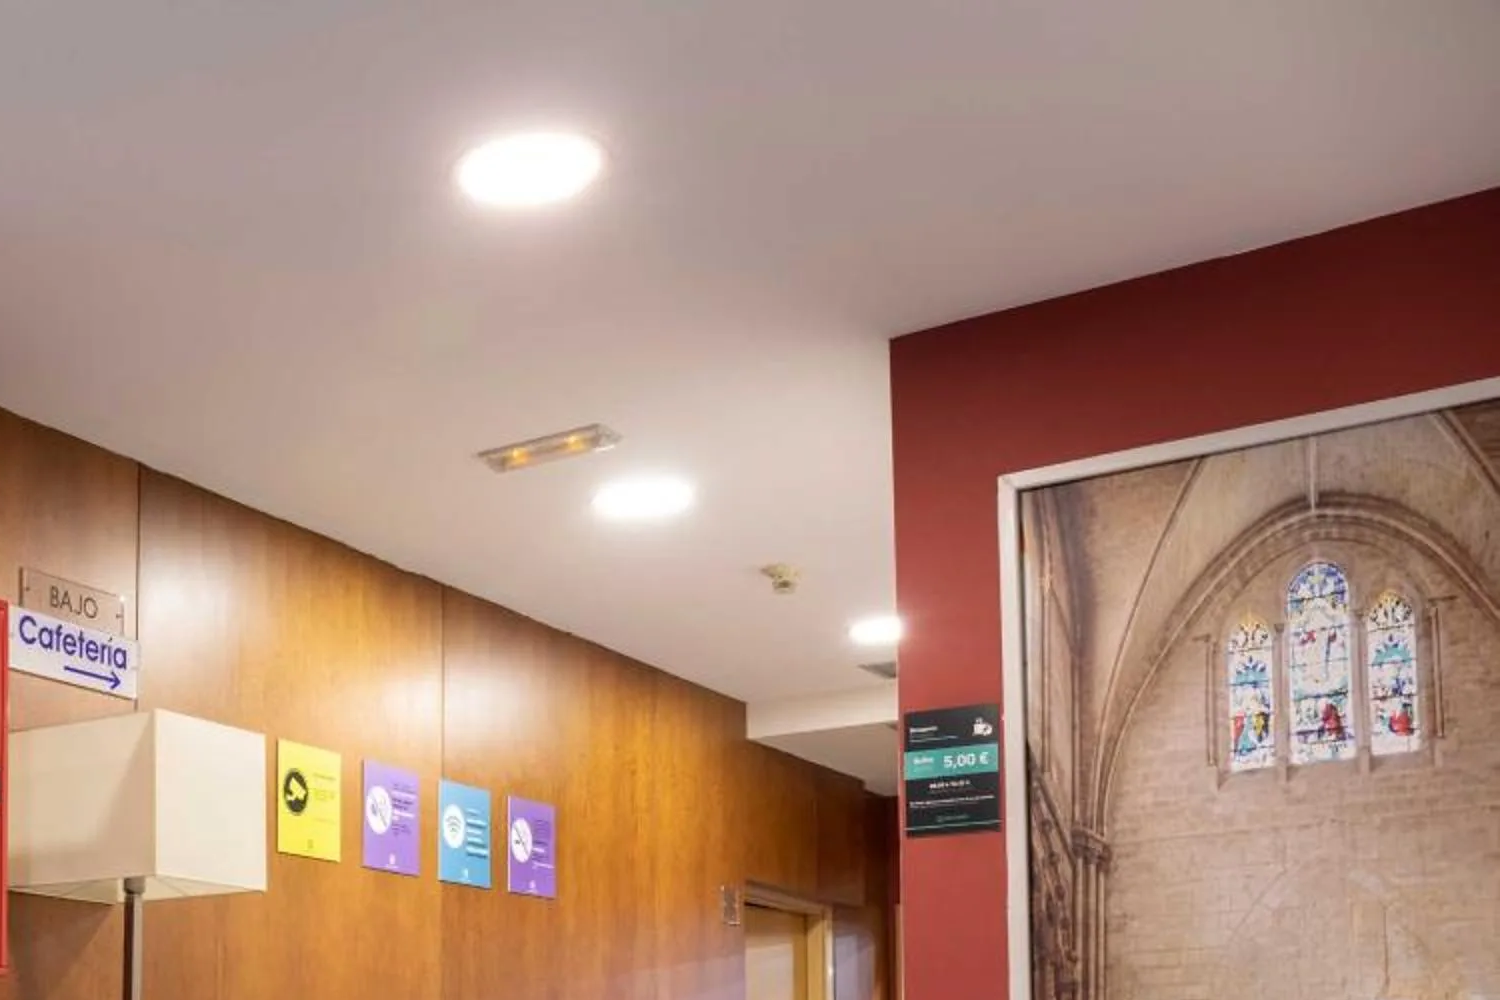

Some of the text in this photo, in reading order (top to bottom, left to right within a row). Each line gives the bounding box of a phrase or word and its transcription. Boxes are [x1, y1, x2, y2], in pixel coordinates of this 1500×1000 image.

[50, 585, 98, 619] BAJO
[19, 615, 128, 670] Cafetería
[943, 753, 977, 769] 5,00
[979, 751, 989, 765] €
